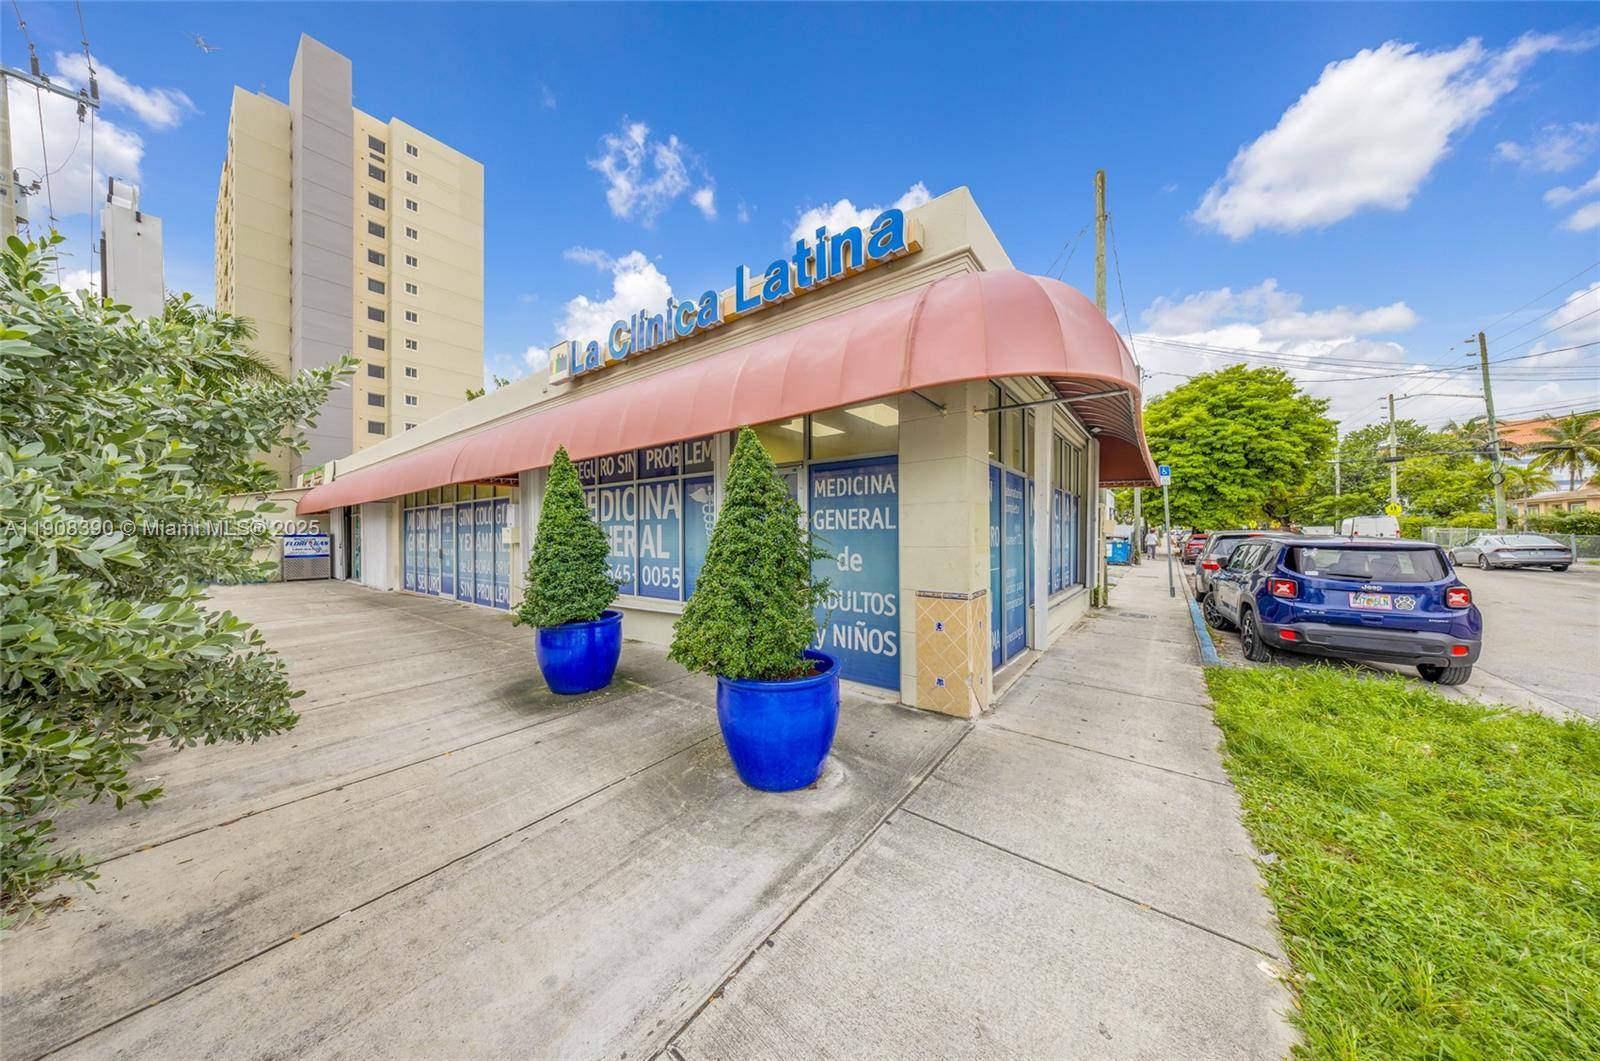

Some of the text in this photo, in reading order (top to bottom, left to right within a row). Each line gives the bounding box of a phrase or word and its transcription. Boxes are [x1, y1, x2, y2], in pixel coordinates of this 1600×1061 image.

[571, 207, 907, 375] La Clinica Latina
[617, 452, 636, 475] SIN
[814, 473, 896, 498] MEDICINA
[584, 482, 680, 523] EDICINA
[813, 507, 896, 531] GENERAL
[603, 524, 670, 559] NERAL
[837, 546, 863, 572] de
[814, 620, 898, 657] y NIÑOS
